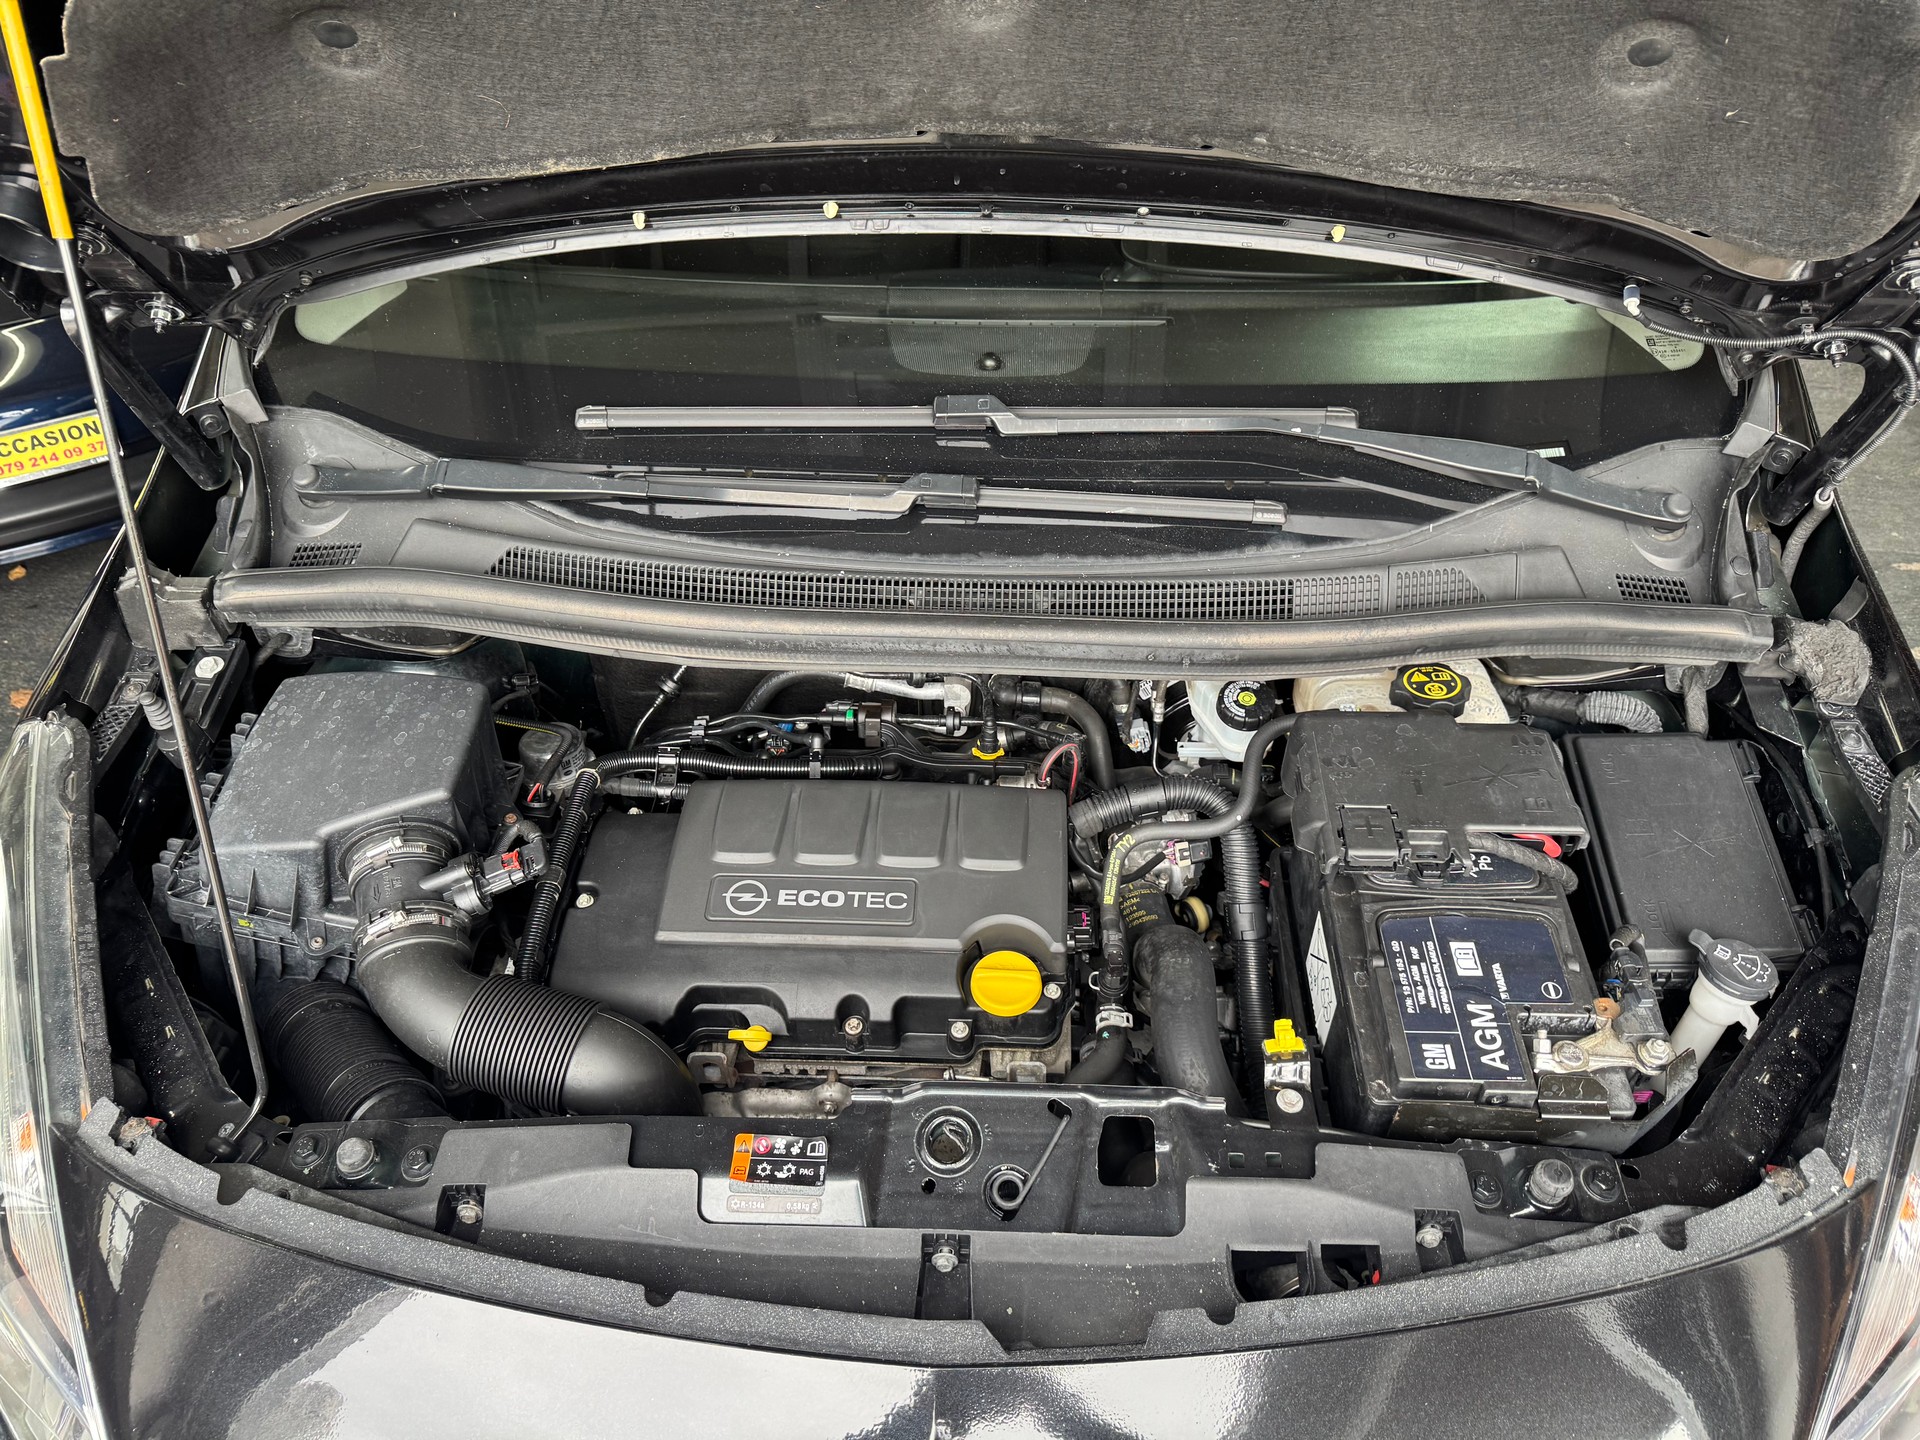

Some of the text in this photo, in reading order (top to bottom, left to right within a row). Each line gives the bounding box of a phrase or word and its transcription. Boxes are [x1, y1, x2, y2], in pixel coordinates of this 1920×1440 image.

[28, 452, 59, 468] 214
[63, 446, 83, 459] 09
[87, 440, 105, 453] 37
[1114, 834, 1136, 853] TY2
[777, 889, 908, 909] ECOTEC
[1491, 963, 1508, 993] VARTA
[1467, 1003, 1509, 1071] AGM
[1421, 1043, 1456, 1070] GM
[799, 1168, 814, 1176] PAG
